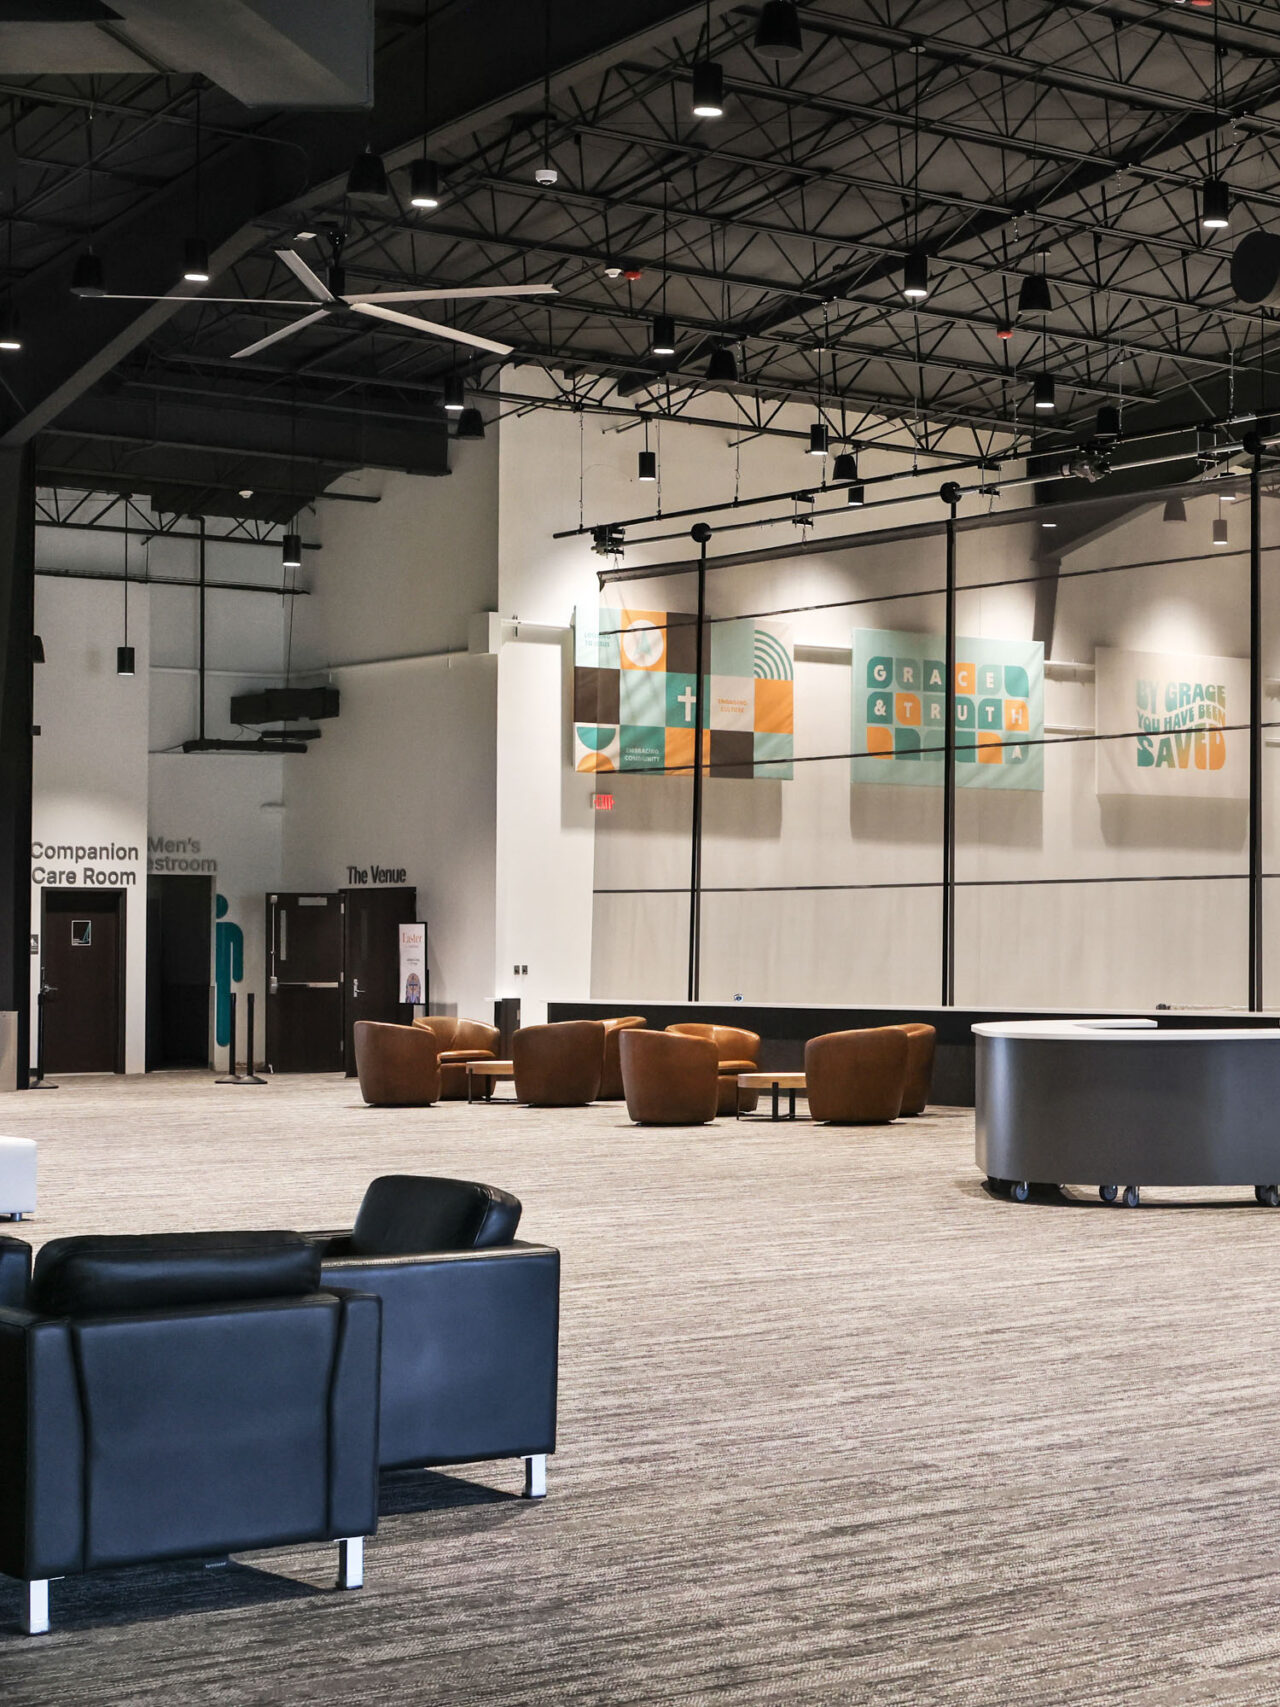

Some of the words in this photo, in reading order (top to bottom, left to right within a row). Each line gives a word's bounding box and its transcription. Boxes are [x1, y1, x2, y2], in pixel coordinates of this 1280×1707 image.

[873, 664, 995, 689] GRACE
[1136, 679, 1158, 715] BY
[1164, 682, 1226, 713] GRACE
[874, 699, 887, 716] &
[903, 701, 1023, 725] TRUTH
[1137, 708, 1160, 733] YOU
[1164, 706, 1195, 732] HAVE
[1198, 703, 1226, 729] BEEN
[1136, 722, 1227, 771] SAVED
[31, 841, 139, 864] Companion
[148, 836, 201, 854] Men's
[32, 866, 77, 885] Care
[83, 867, 137, 885] Room
[347, 865, 368, 885] The
[370, 865, 407, 884] Venue
